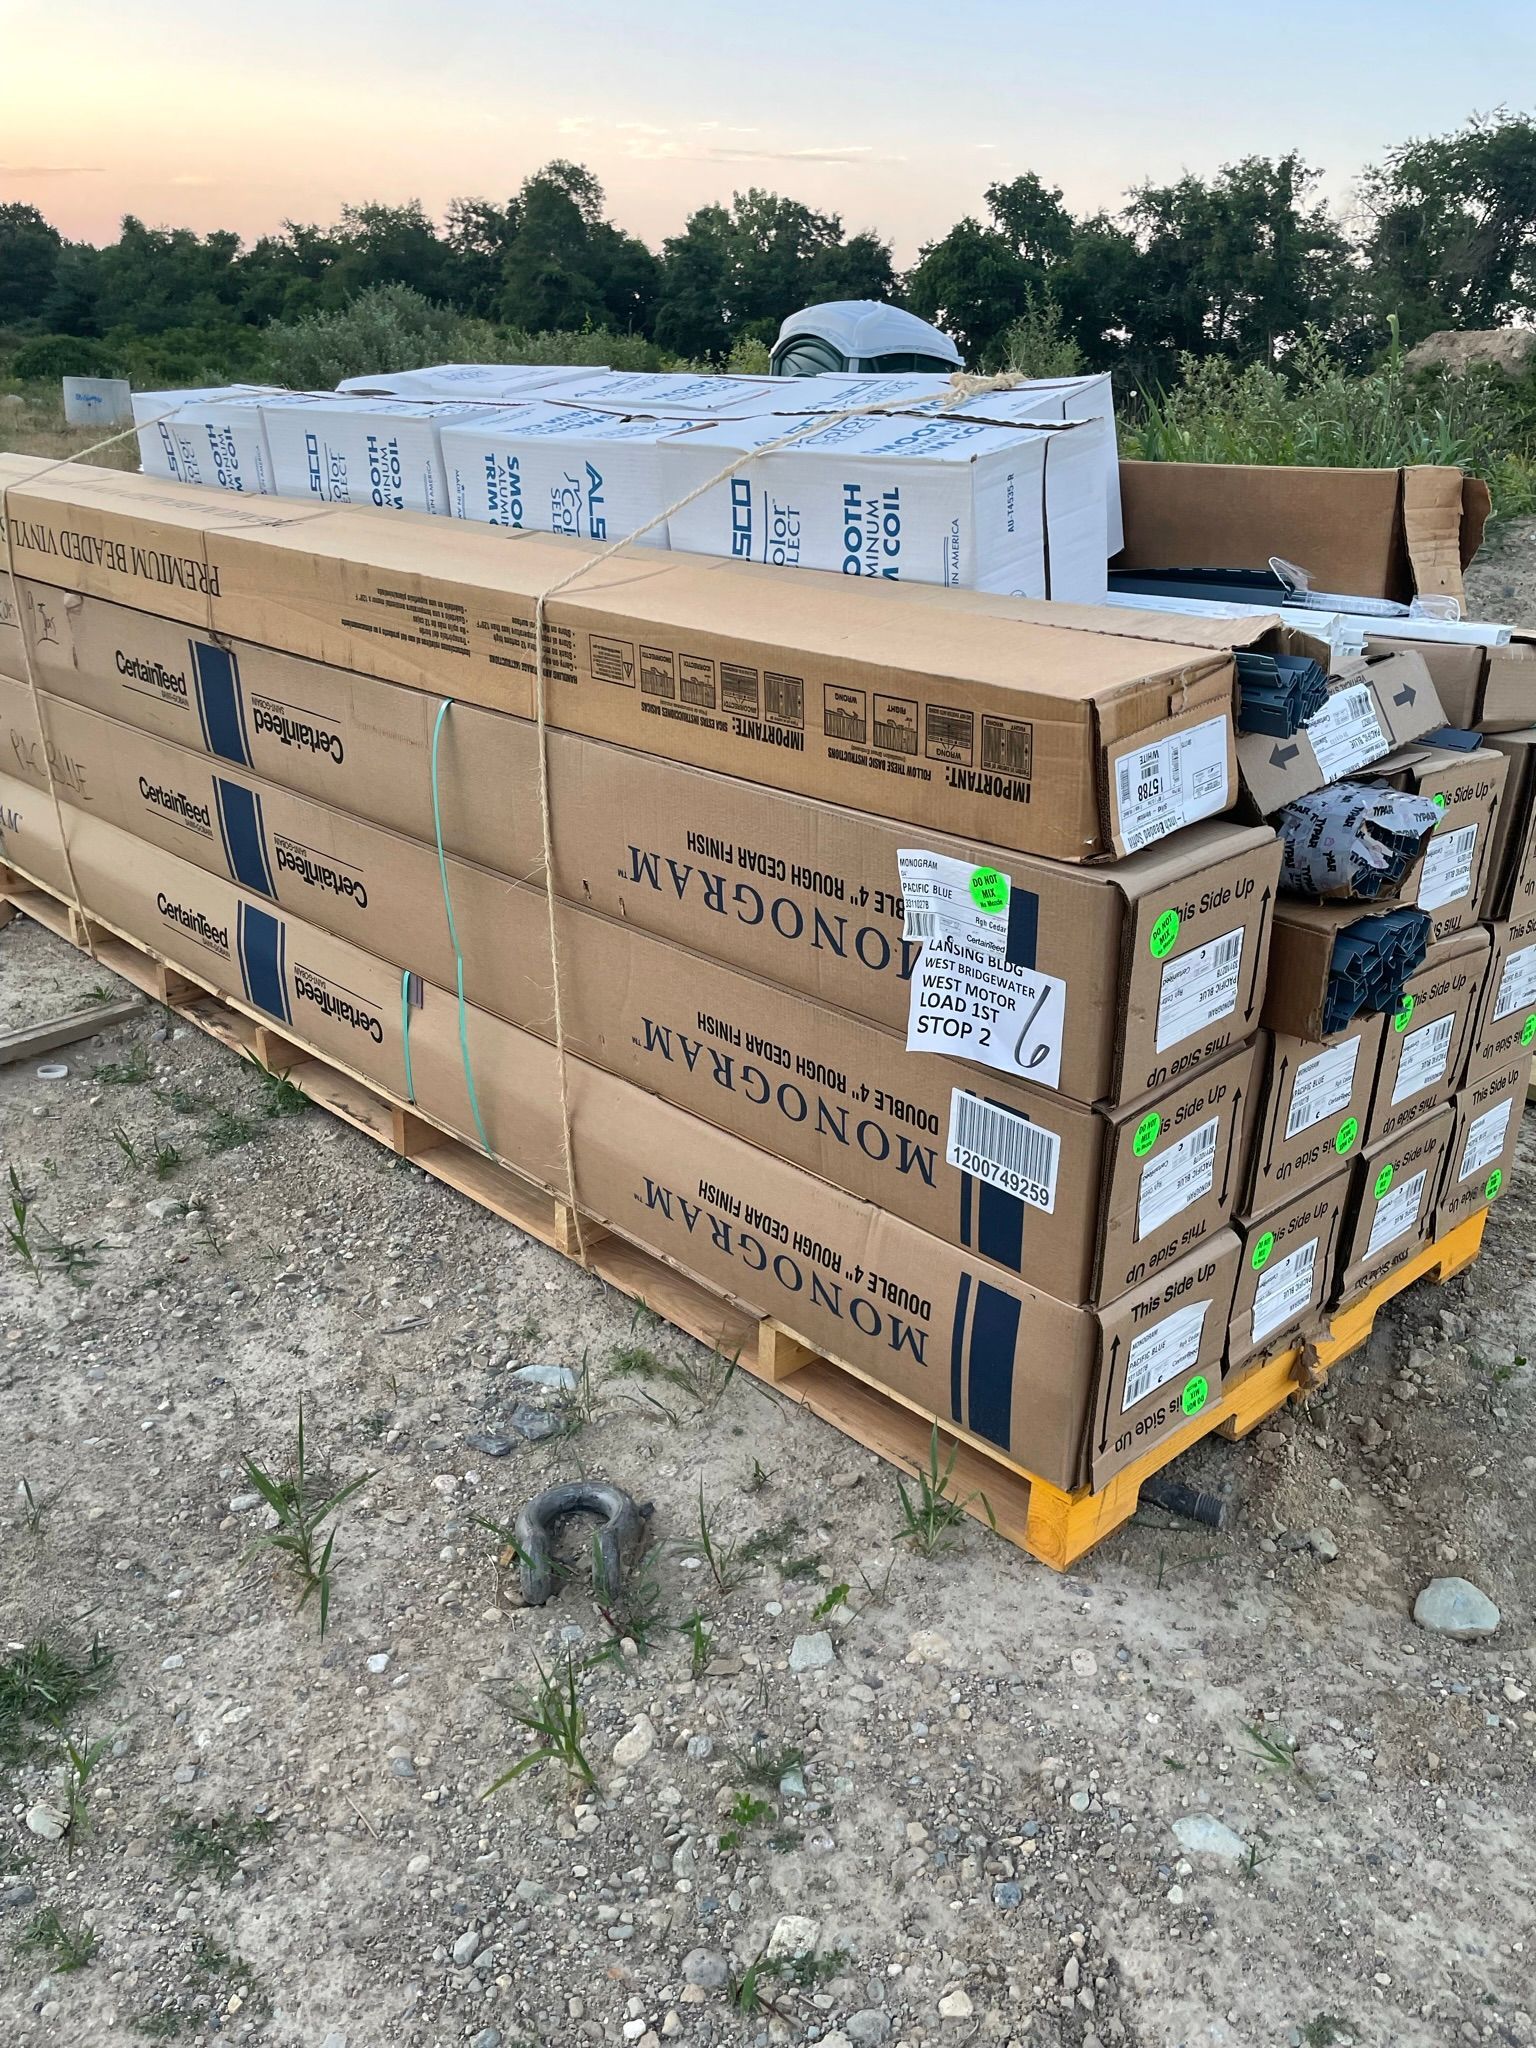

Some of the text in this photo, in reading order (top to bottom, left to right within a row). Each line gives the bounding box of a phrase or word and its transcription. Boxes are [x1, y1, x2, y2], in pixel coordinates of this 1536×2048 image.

[205, 423, 228, 488] OOTH
[223, 425, 240, 470] COIL
[389, 438, 402, 489] COIL
[305, 434, 324, 502] SCO
[328, 450, 342, 500] olor
[367, 436, 384, 507] OOTH
[485, 453, 498, 510] TRIM
[507, 455, 523, 529] SMO
[586, 461, 607, 542] ALS
[10, 519, 58, 557] VINYL
[731, 479, 751, 562] SCO
[769, 503, 788, 567] olor
[842, 483, 863, 577] OOTH
[882, 487, 901, 558] COIL
[59, 529, 128, 573] BEADED
[864, 500, 880, 580] MINUM
[951, 518, 960, 585] IN AMERICA
[131, 547, 223, 598] PREMIUM
[115, 649, 188, 697] CertainTeed
[834, 692, 858, 705] WRONG
[886, 704, 907, 715] RIGHT
[252, 708, 344, 765] CertainTeed
[699, 715, 716, 730] ESTAS
[715, 718, 729, 733] SIGA
[731, 716, 805, 753] IMPORTANTE:
[827, 746, 869, 768] INSTRUCTIONS
[868, 755, 886, 772] BASIC
[887, 760, 906, 777] THESE
[936, 747, 962, 761] WRONG
[1139, 750, 1160, 766] WHITE
[906, 764, 932, 782] FOLLOW
[945, 766, 1032, 804] IMPORTANT:
[1137, 776, 1164, 803] 15788
[138, 776, 211, 828] CertainTeed
[1373, 805, 1394, 816] TYPAR
[1453, 782, 1489, 804] Side Up
[1142, 821, 1166, 840] Beaded
[1307, 817, 1327, 849] TYPAR
[1413, 811, 1438, 823] TYPAR
[1127, 831, 1145, 850] Soffit
[275, 847, 368, 910] CertainTeed
[686, 830, 905, 920] BLE 4" ROUGH CEDAR FINISH
[899, 857, 938, 870] MONOGRAM
[972, 873, 999, 888] DO NOT
[902, 881, 953, 900] PACIFIC BLUE
[981, 888, 997, 899] MIX
[1199, 877, 1255, 914] Side Up
[157, 892, 229, 950] CertainTeed
[975, 916, 1007, 934] Rgh Cedar
[1152, 912, 1173, 941] DO NOT
[1158, 928, 1171, 946] MIX
[1443, 915, 1462, 934] This
[1508, 923, 1525, 942] This
[928, 937, 1024, 977] LANSING BLDG
[966, 933, 1006, 954] CertainTeed
[922, 974, 1016, 1012] WEST MOTOR
[925, 956, 1036, 1000] WEST BRIDGEWATER
[1198, 975, 1237, 1003] PACIFIC BLUE
[1429, 979, 1451, 1001] Side
[1452, 973, 1467, 991] Up
[293, 975, 384, 1045] CertainTeed
[920, 991, 1001, 1024] LOAD 1ST
[1014, 983, 1052, 1069] 6
[916, 1014, 993, 1048] STOP 2
[1482, 1033, 1513, 1060] Side Up
[697, 1011, 939, 1137] DOUBLE 4" ROUGH CEDAR FINISH
[1146, 1031, 1231, 1089] This Side Up
[1174, 1083, 1227, 1124] Side Up
[1472, 1069, 1520, 1106] This Side Up
[1382, 1093, 1438, 1135] This Side Up
[1275, 1146, 1320, 1181] Side Up
[1401, 1138, 1437, 1168] Side Up
[952, 1145, 1050, 1207] 1200749259
[1287, 1201, 1329, 1235] Side Up
[697, 1179, 932, 1322] DOUBLE 4" ROUGH CEDAR FINISH
[1125, 1219, 1207, 1285] This Side Up
[1130, 1262, 1217, 1323] This Side Up
[1129, 1340, 1167, 1369] PACIFIC BLUE
[1114, 1406, 1166, 1454] Side Up
